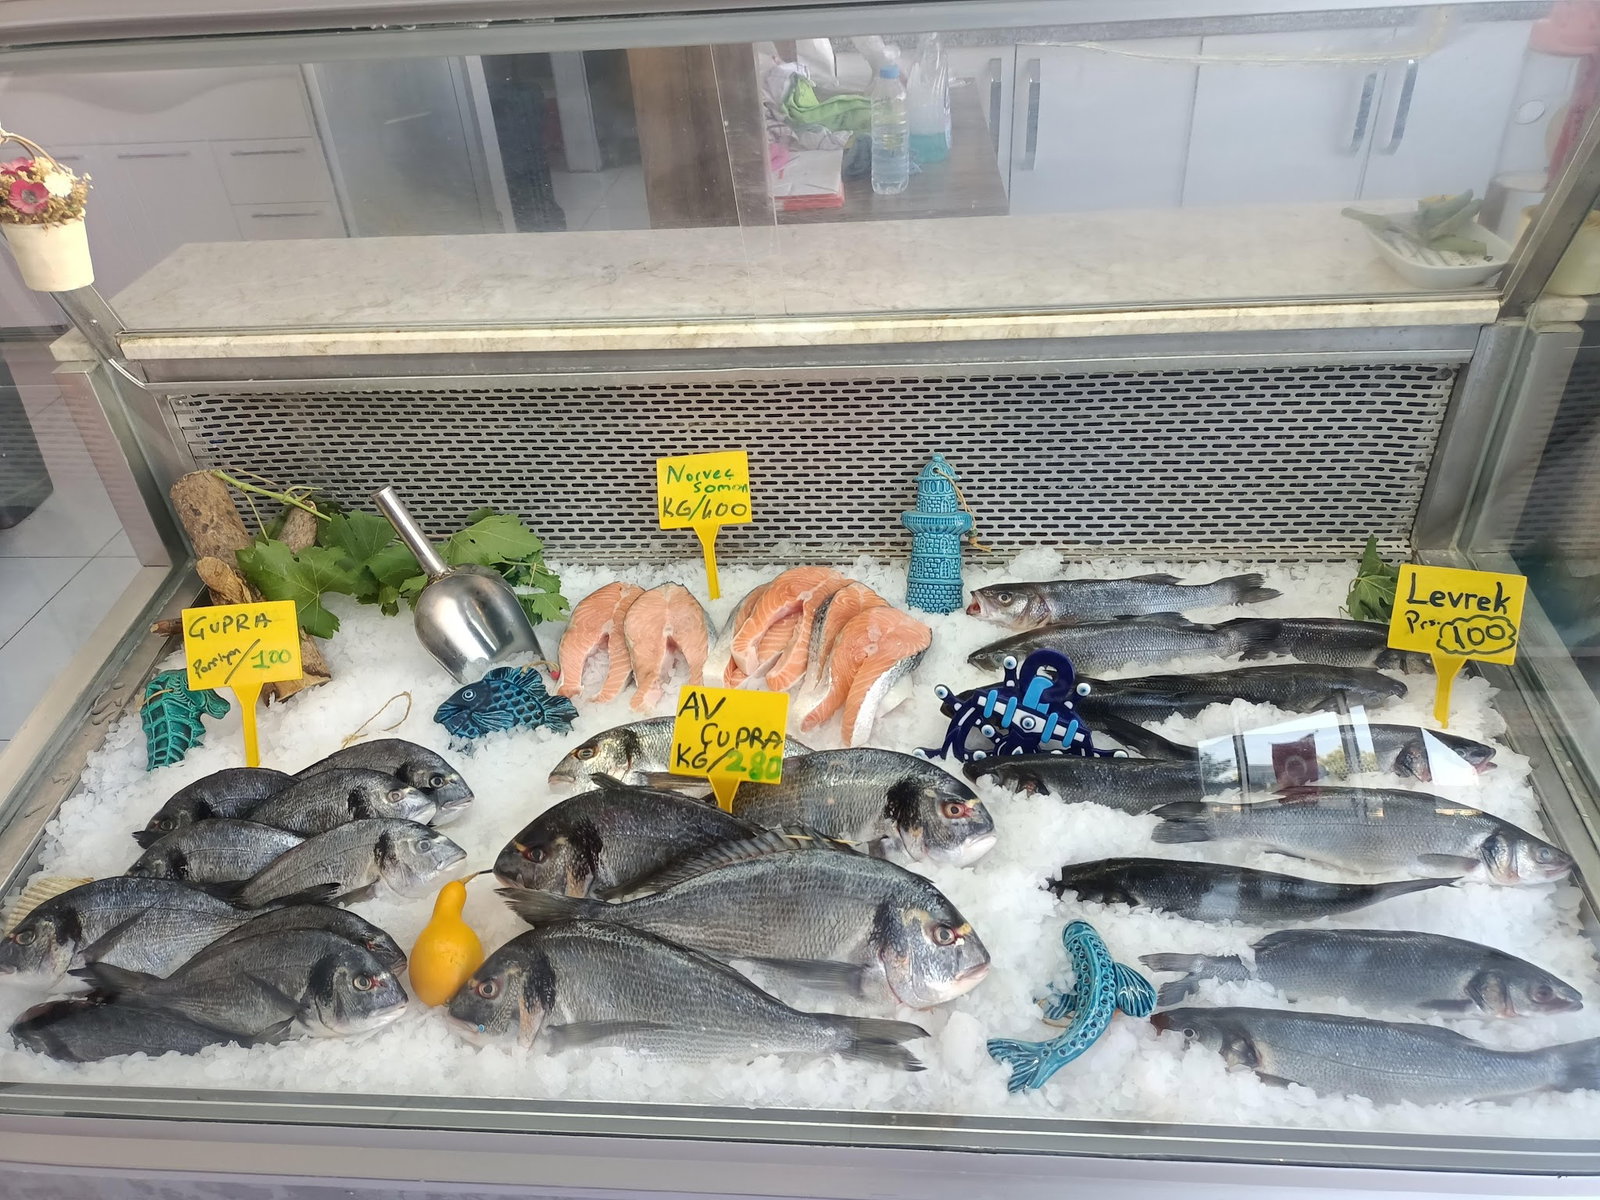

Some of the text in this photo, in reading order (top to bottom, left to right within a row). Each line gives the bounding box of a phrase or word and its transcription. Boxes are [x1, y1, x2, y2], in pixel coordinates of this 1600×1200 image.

[1406, 572, 1511, 615] Levrek
[1452, 623, 1506, 650] 100
[678, 691, 727, 721] AV
